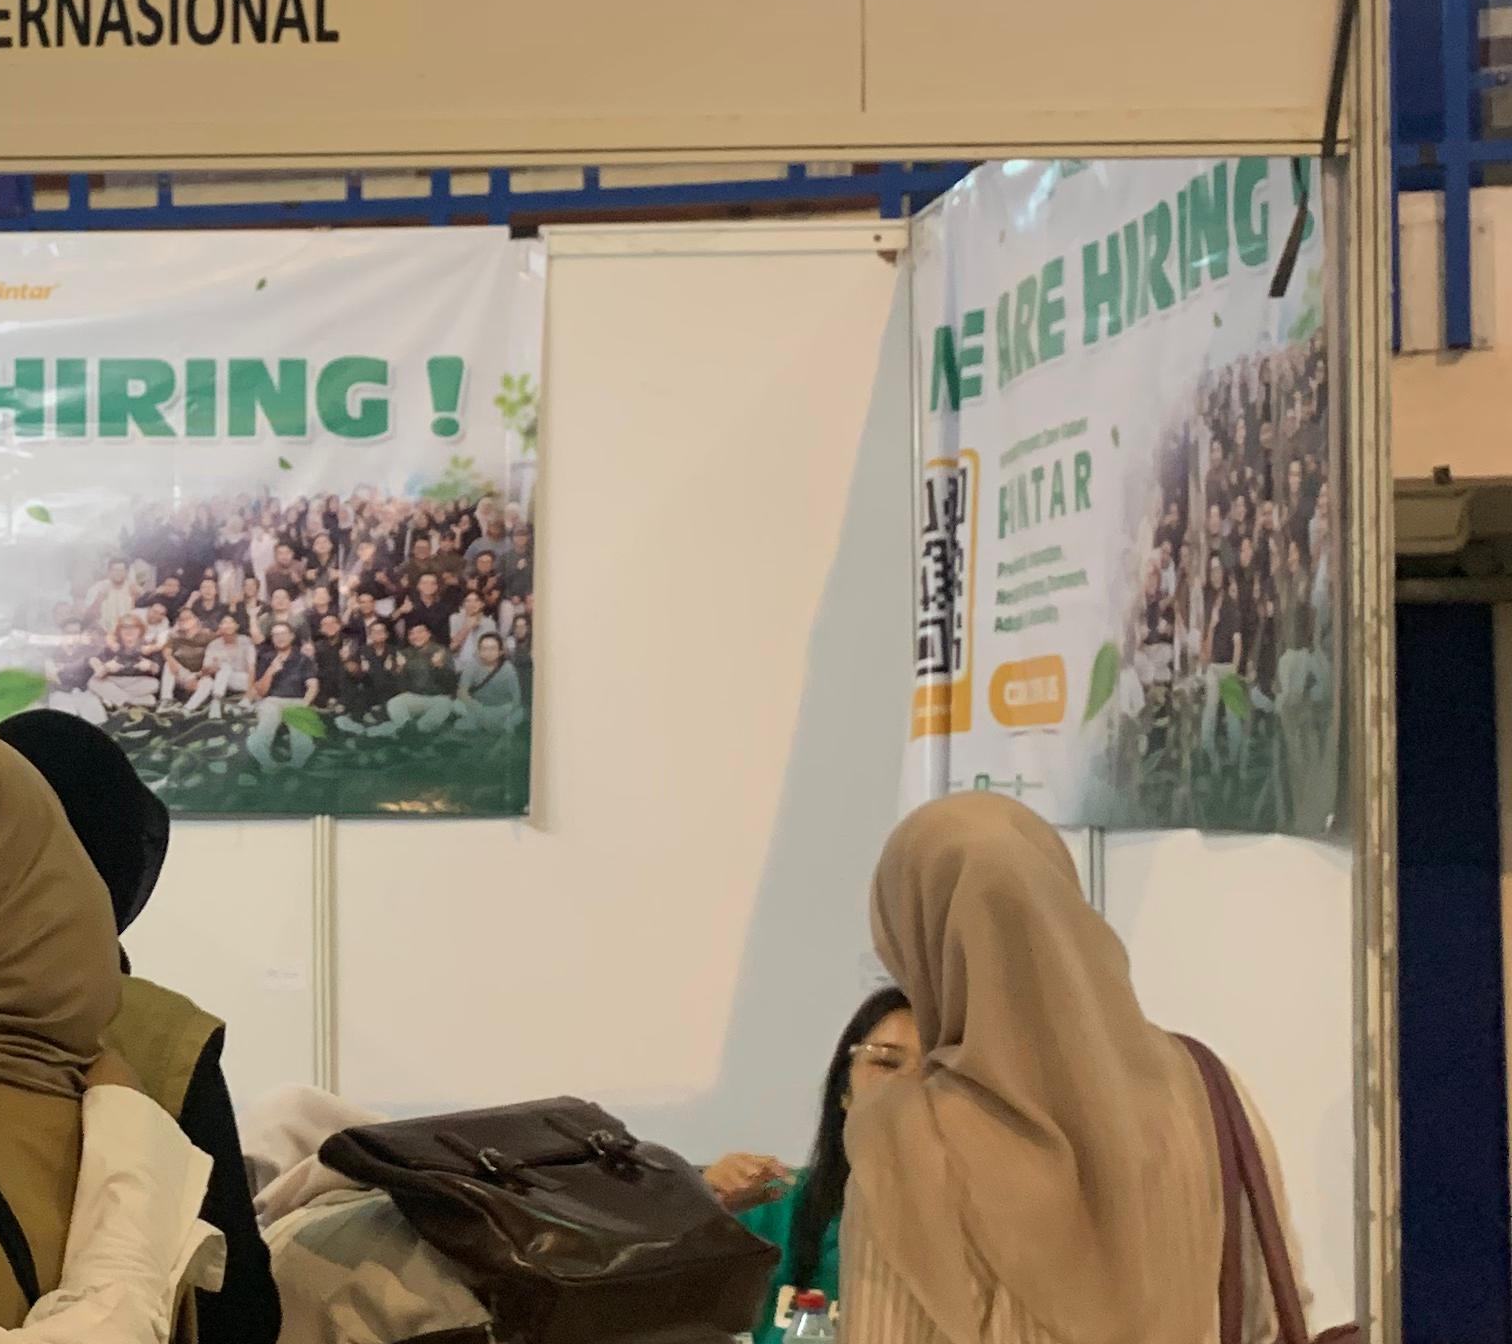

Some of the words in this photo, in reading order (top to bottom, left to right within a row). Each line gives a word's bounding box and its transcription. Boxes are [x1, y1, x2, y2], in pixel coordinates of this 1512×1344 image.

[996, 257, 1066, 389] ARE
[1083, 158, 1269, 345] HIRING
[426, 356, 465, 437] !
